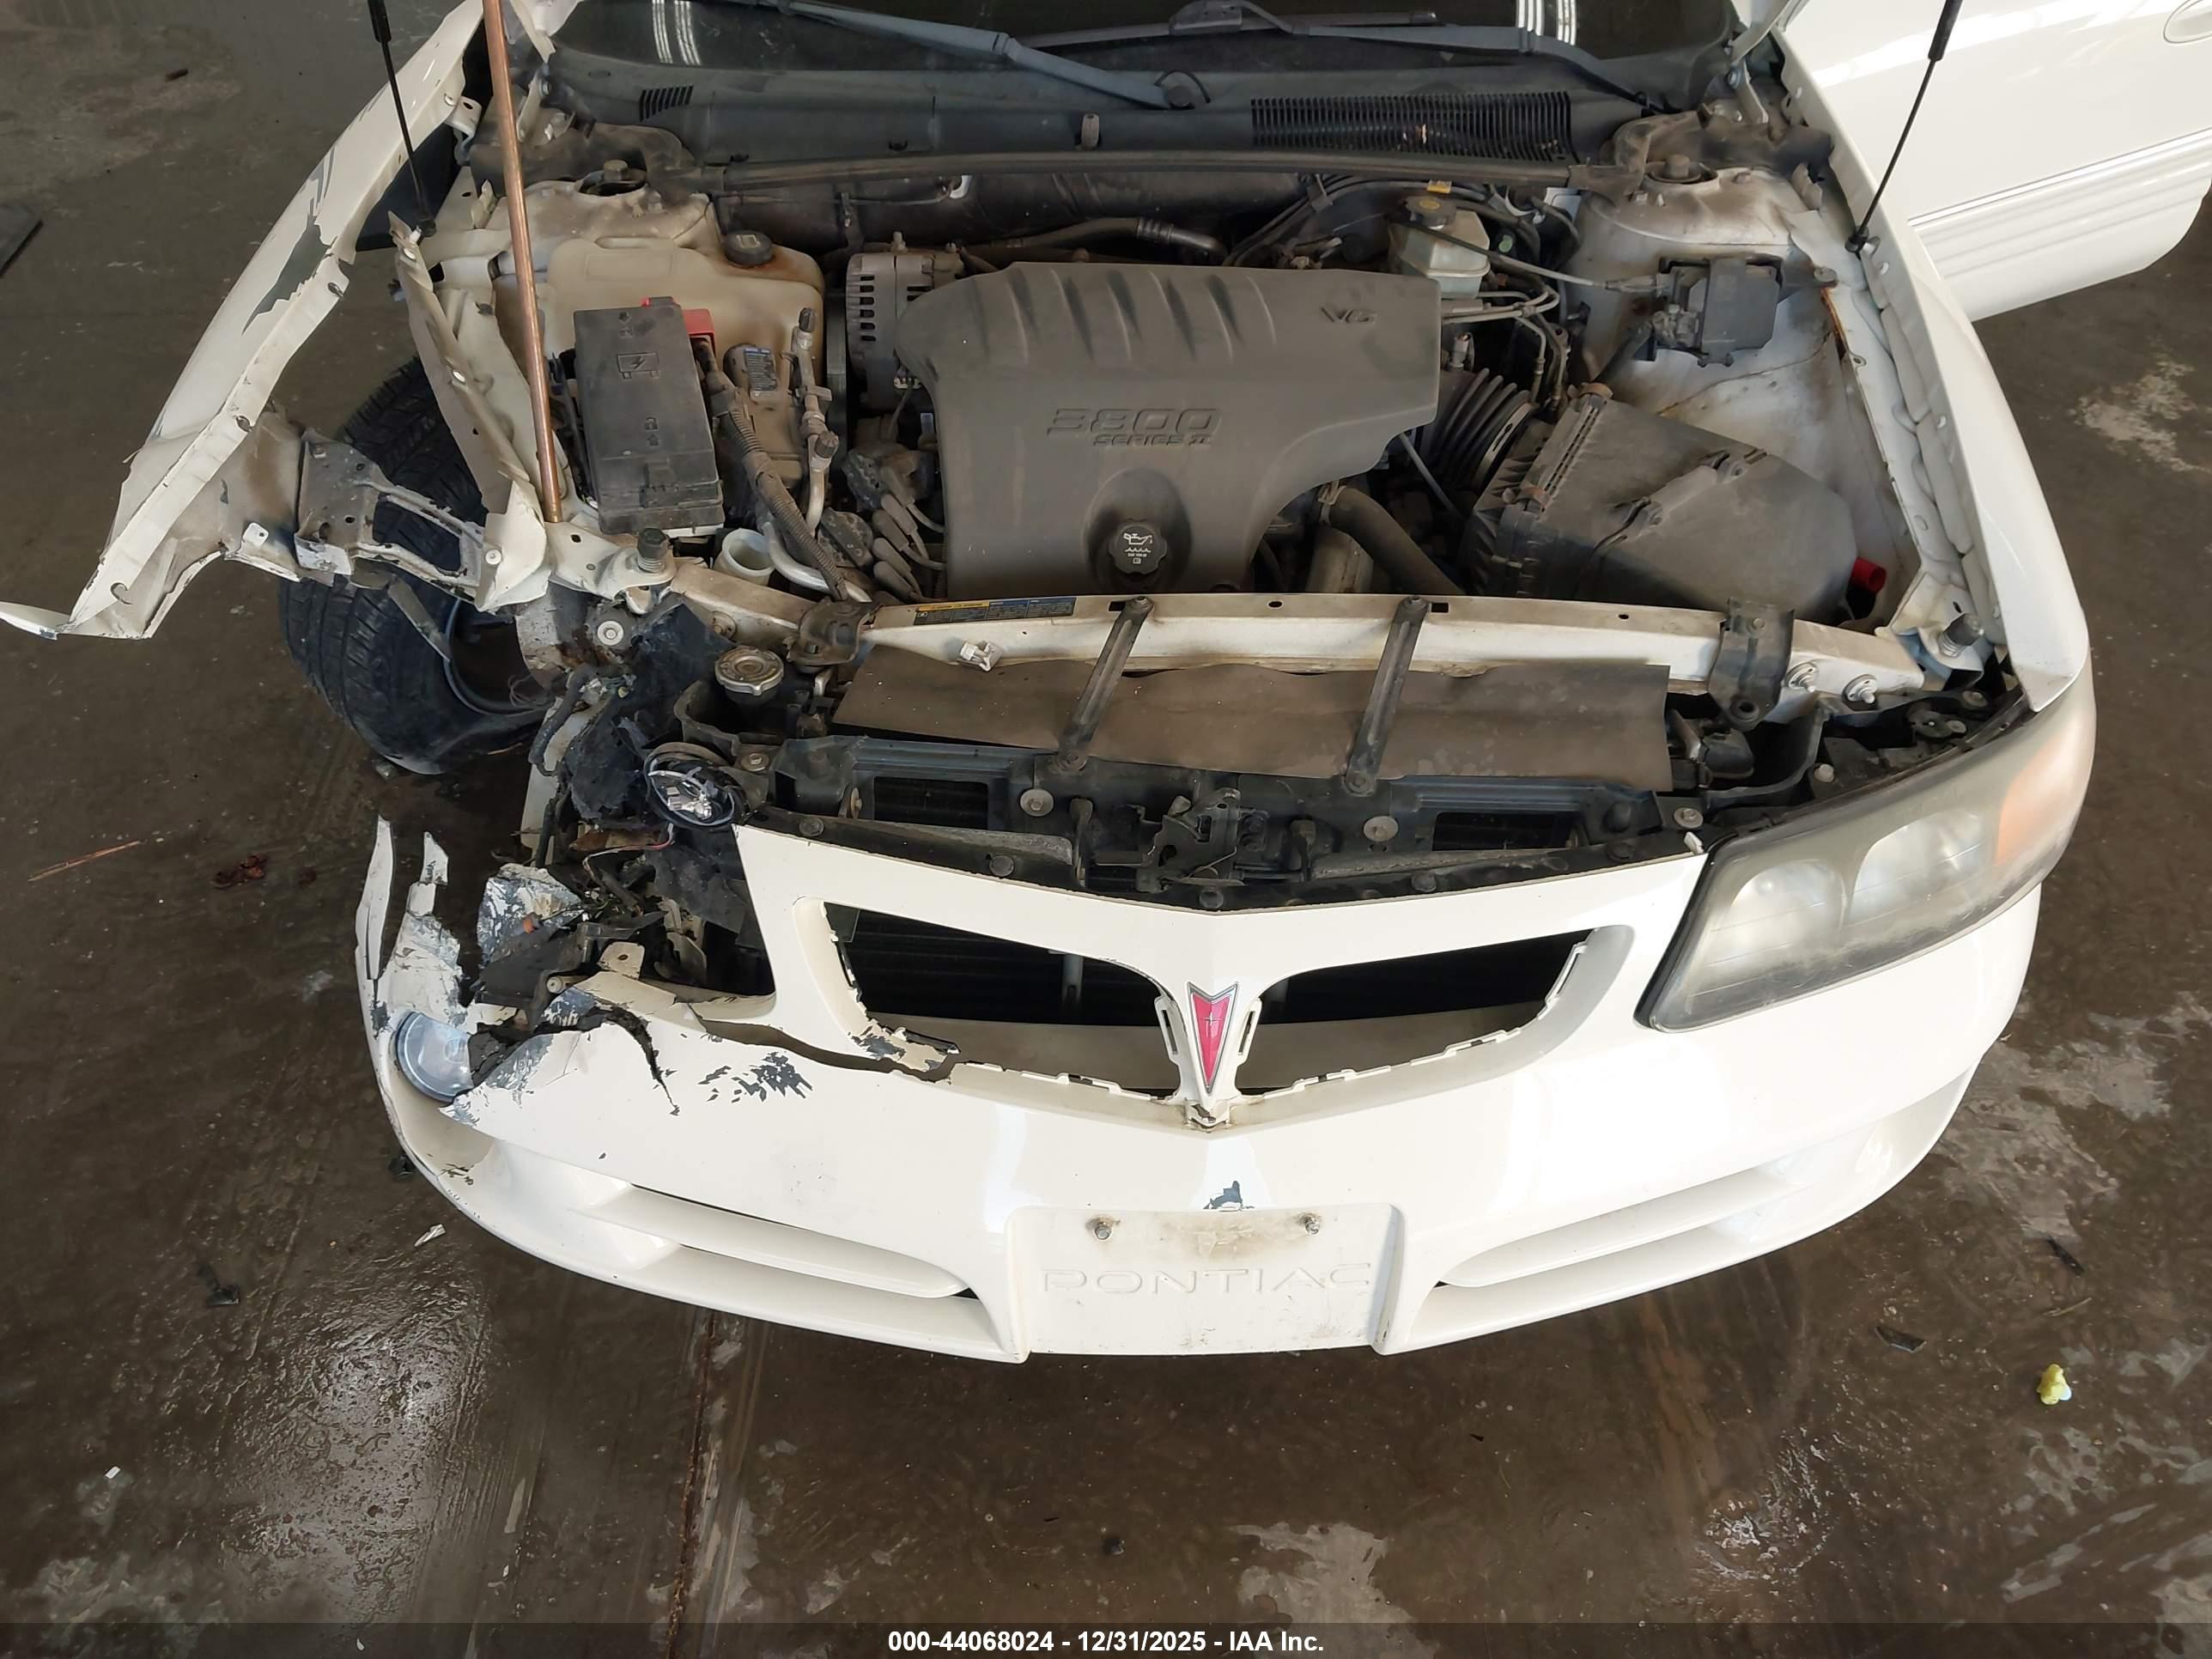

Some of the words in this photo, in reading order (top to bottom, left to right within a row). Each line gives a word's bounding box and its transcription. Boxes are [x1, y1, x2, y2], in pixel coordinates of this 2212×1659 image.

[1320, 307, 1376, 325] V6
[1046, 407, 1222, 436] 3800
[1092, 433, 1184, 447] SERIES
[1042, 1262, 1371, 1295] PONTIAC
